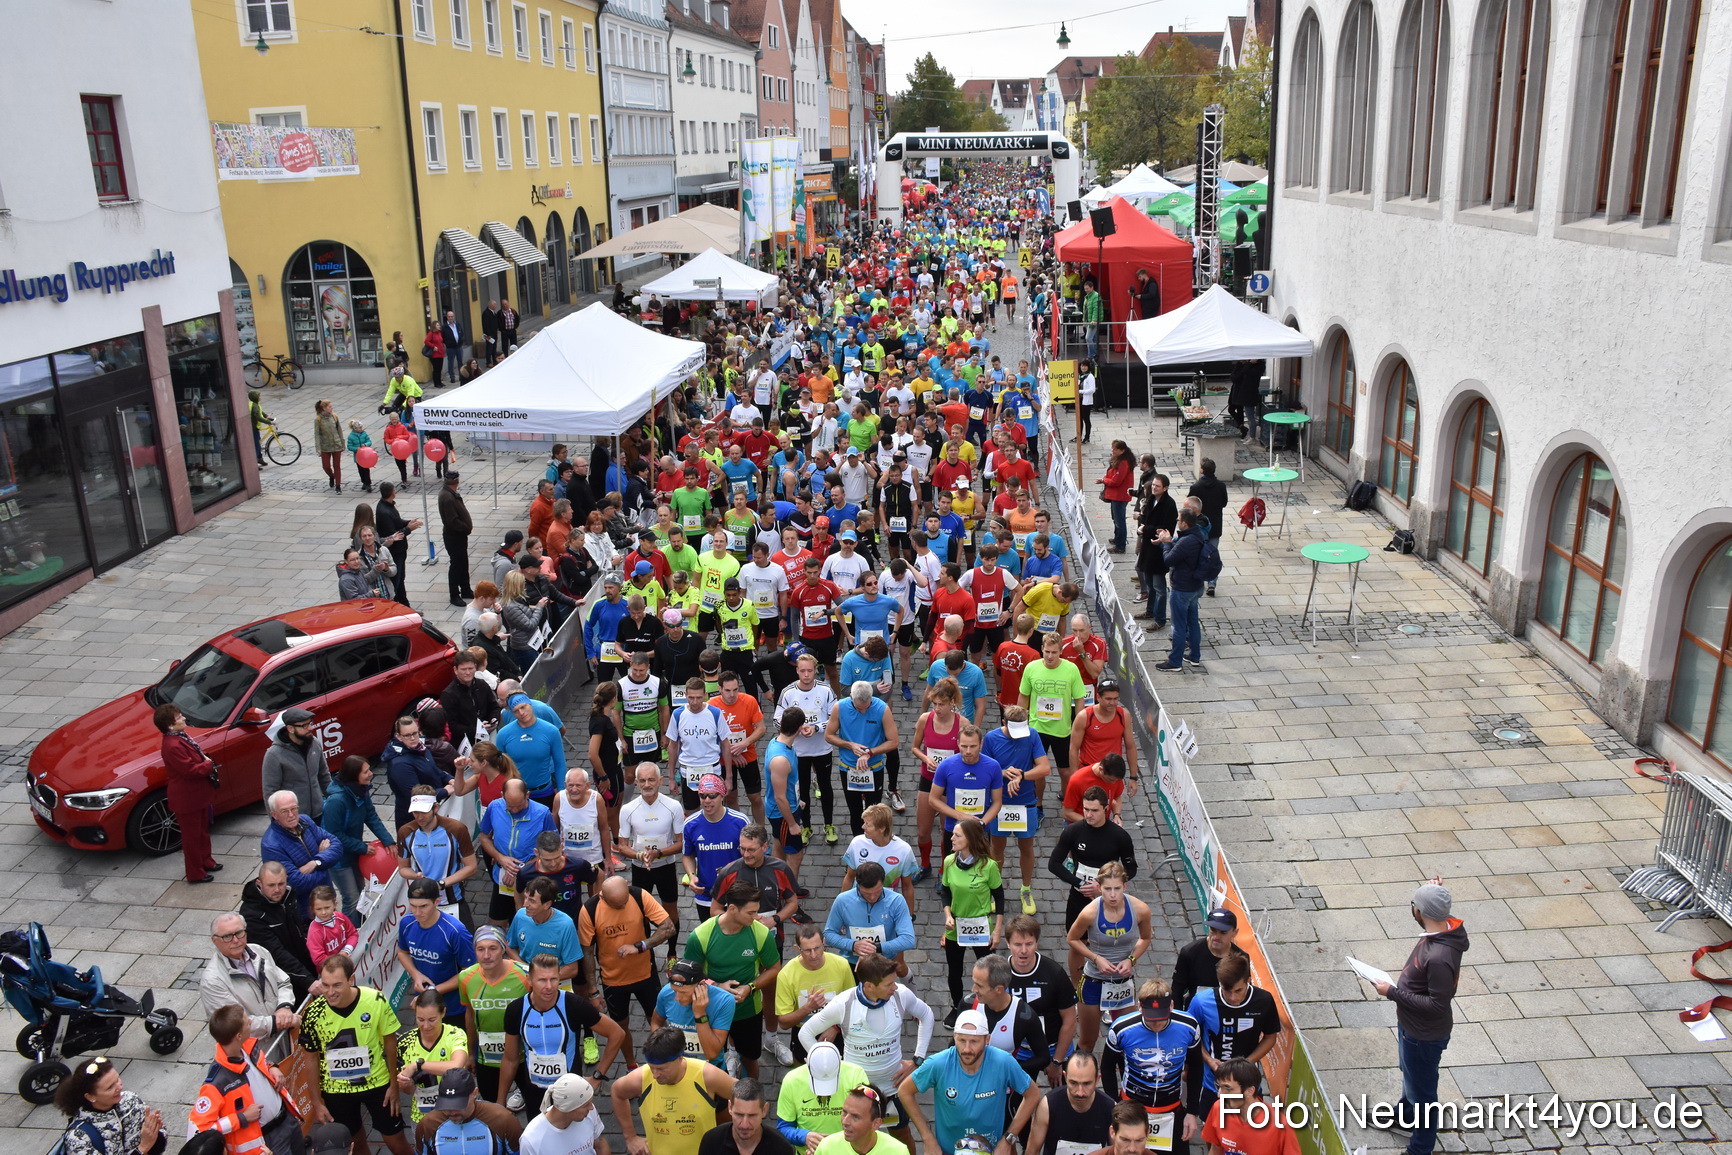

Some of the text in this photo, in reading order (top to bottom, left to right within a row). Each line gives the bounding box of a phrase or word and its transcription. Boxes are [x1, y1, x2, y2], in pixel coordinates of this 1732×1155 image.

[918, 137, 1035, 150] MINI NEUMARKT.
[829, 254, 838, 264] A
[1021, 253, 1029, 263] A
[314, 262, 344, 271] hailer
[0, 249, 176, 303] dlung Rupprecht
[1050, 372, 1075, 382] Jugend
[1057, 380, 1071, 388] lauf
[423, 408, 528, 420] BMW ConnectedDrive
[424, 419, 454, 427] Vernetzt,
[980, 607, 996, 616] 2092
[728, 633, 744, 641] 2681
[1045, 703, 1055, 711] 48
[850, 775, 870, 783] 2648
[962, 797, 978, 806] 227
[1004, 813, 1020, 821] 299
[567, 831, 589, 841] 2182
[698, 842, 733, 851] Hofmühl
[961, 926, 985, 935] 2232
[408, 946, 440, 960] SYSCAD
[1106, 988, 1131, 1001] 2428
[865, 1048, 891, 1058] ULMER
[333, 1057, 363, 1069] 2690
[533, 1063, 561, 1075] 2706
[974, 1090, 996, 1099] BOCK
